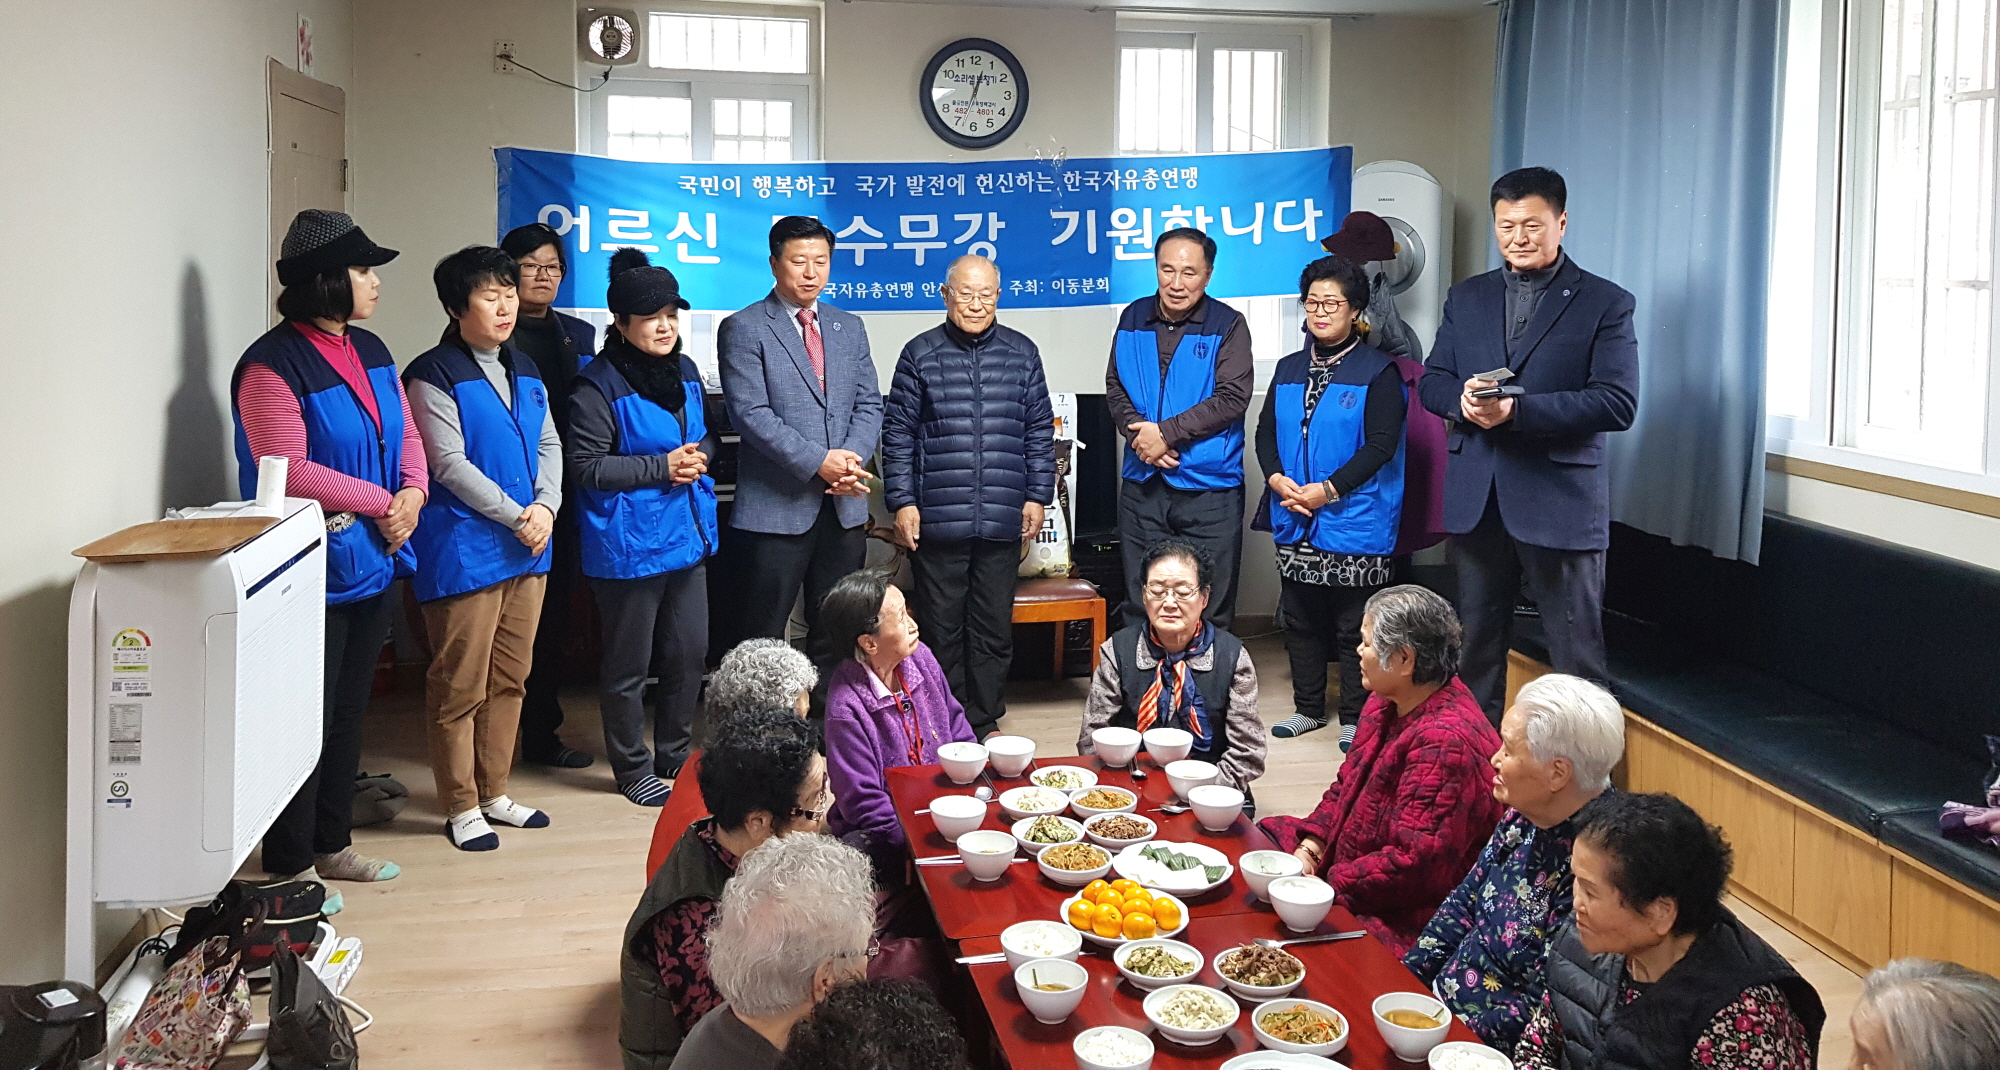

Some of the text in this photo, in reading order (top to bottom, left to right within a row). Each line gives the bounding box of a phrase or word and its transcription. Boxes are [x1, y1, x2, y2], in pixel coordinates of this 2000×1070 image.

[955, 58, 965, 68] 11
[969, 55, 981, 66] 12
[989, 60, 994, 70] 1
[943, 69, 955, 79] 10
[999, 73, 1008, 83] 2
[1003, 90, 1012, 101] 3
[942, 103, 950, 113] 8
[976, 108, 994, 116] 4801
[997, 107, 1006, 117] 4
[954, 116, 962, 126] 7
[986, 118, 994, 128] 5
[969, 121, 978, 132] 6
[677, 165, 1198, 198] 국민이 행복하고 국가 발전에 헌신하는 한국자유총연맹
[537, 198, 1323, 267] 어르신 수무강 기원합니다
[819, 280, 914, 299] 국자유총연맹
[1009, 279, 1044, 297] 주최:
[1051, 277, 1110, 296] 이동분회
[1059, 394, 1065, 403] 7
